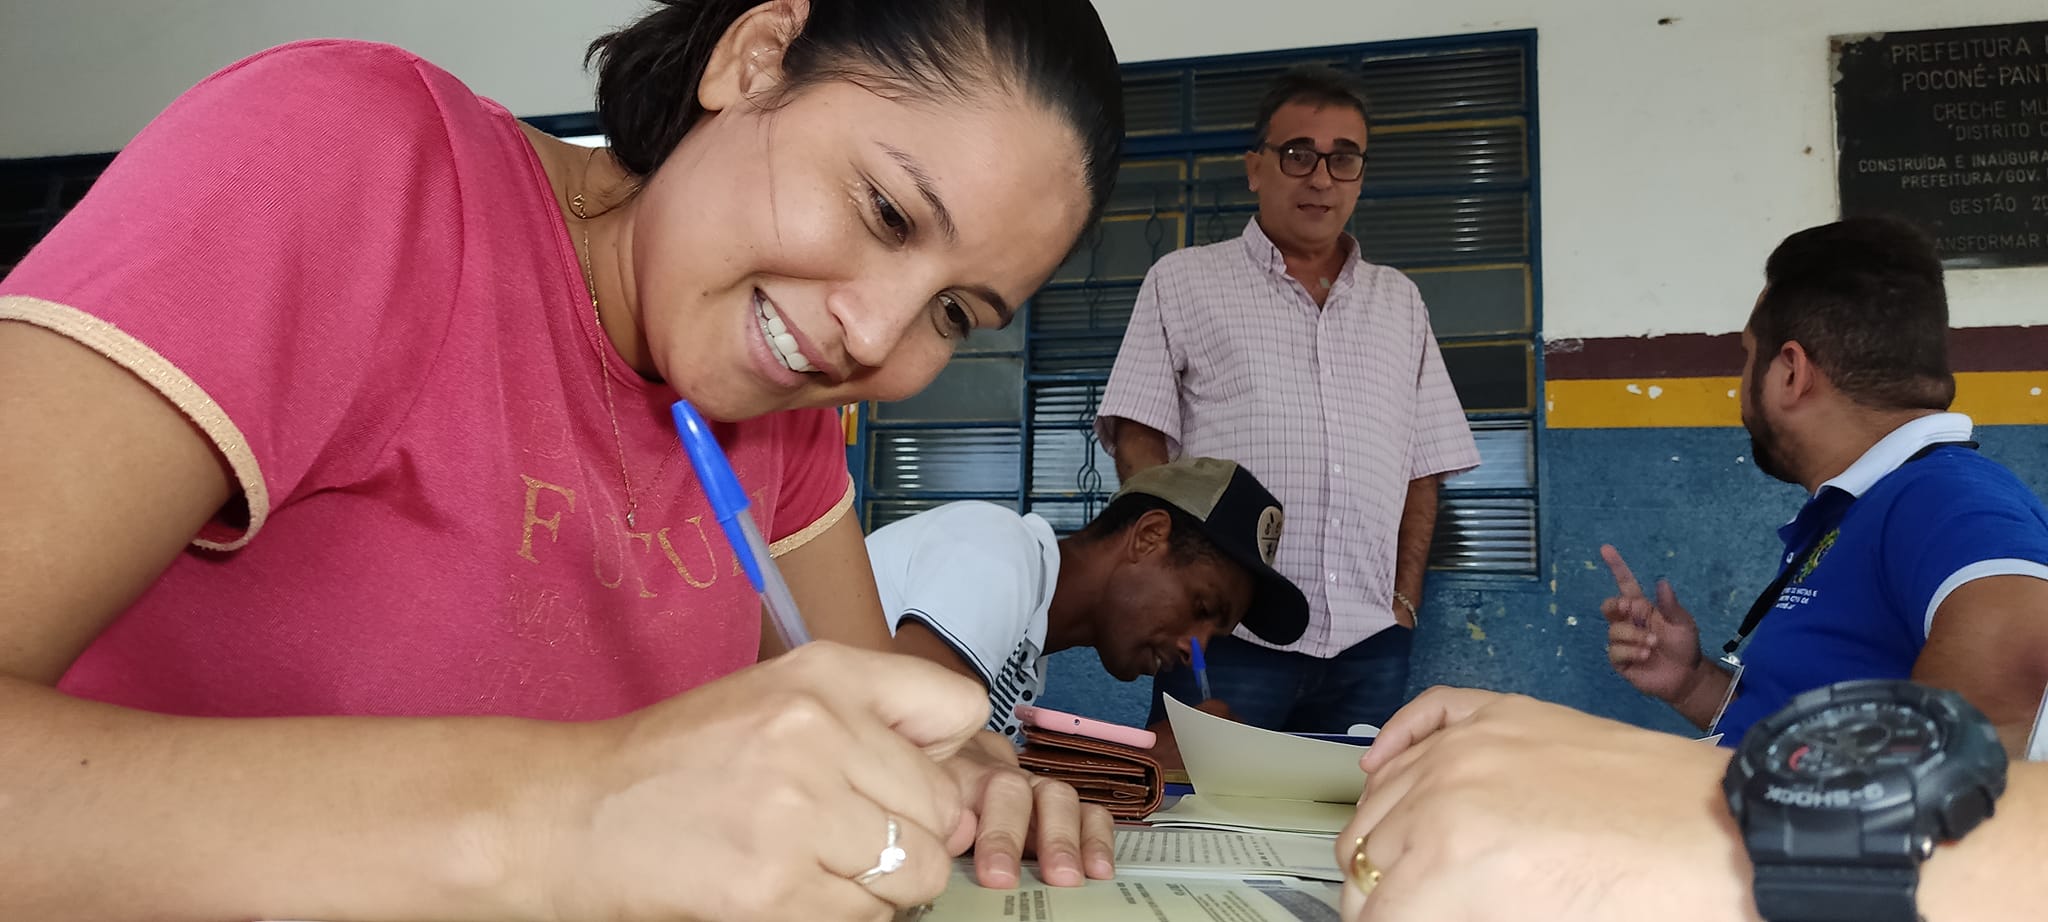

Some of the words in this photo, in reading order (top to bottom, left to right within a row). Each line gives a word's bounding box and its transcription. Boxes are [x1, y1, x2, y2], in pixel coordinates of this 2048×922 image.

[1891, 36, 2031, 64] PREFEITURA
[1933, 100, 2006, 121] CRECHE
[1858, 153, 1948, 173] CONSTRUÍDA
[1955, 154, 1966, 169] E
[1950, 193, 2017, 215] GESTÃO
[1934, 233, 2041, 250] ANSFORMAR
